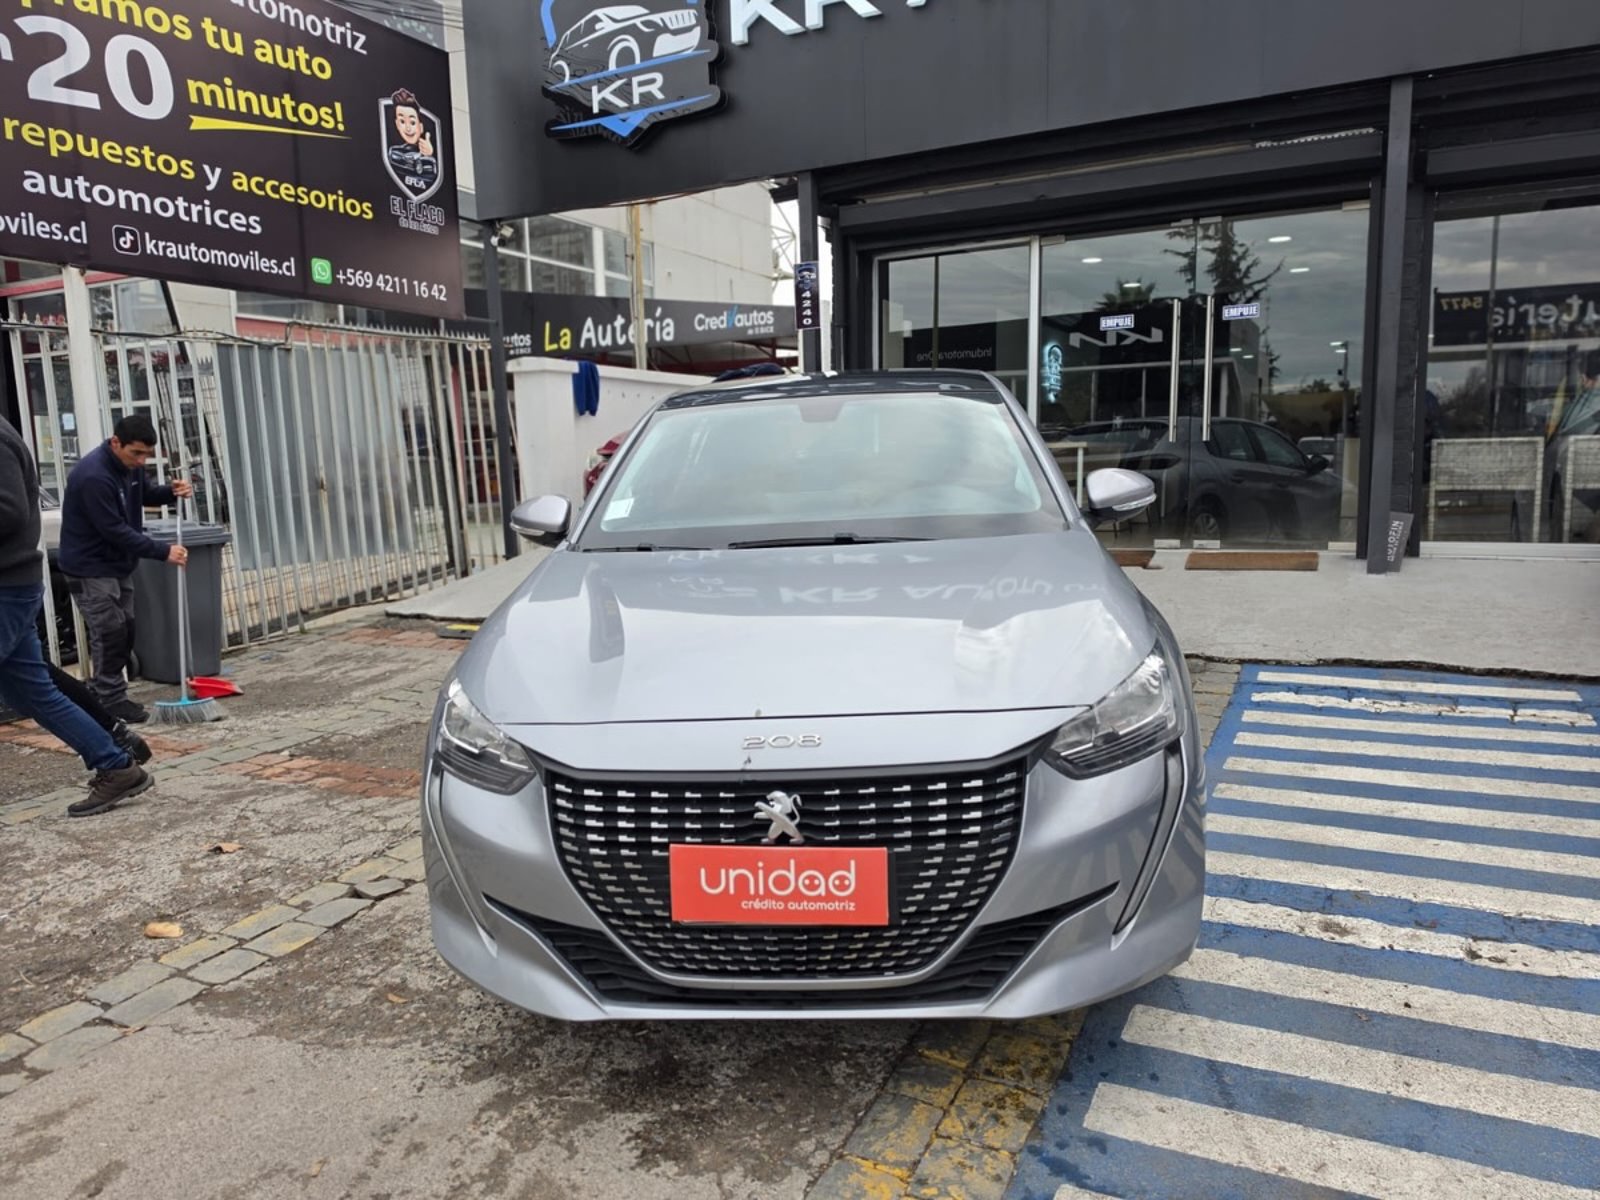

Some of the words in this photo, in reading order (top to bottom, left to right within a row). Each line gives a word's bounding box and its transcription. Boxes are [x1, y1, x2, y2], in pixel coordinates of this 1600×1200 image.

[20, 0, 193, 40] amos
[201, 17, 244, 56] tu
[254, 38, 332, 80] auto
[13, 15, 175, 120] 20
[186, 76, 345, 132] minutos!
[591, 72, 665, 114] KR
[3, 117, 196, 180] repuestos
[202, 163, 222, 191] y
[232, 170, 374, 220] accesorios
[22, 169, 263, 236] automotrices
[0, 213, 88, 244] viles.cl
[145, 231, 296, 277] krautomoviles.cl
[336, 268, 373, 289] +569
[376, 273, 408, 295] 4211
[413, 280, 429, 298] 16
[431, 284, 447, 301] 42
[801, 290, 812, 325] 4240
[1101, 316, 1132, 328] EMPUJE
[1223, 306, 1258, 318] EMPUJE
[544, 321, 572, 352] La
[742, 734, 821, 749] 208
[700, 859, 856, 897] unidad
[741, 899, 784, 911] crédito
[787, 899, 856, 912] automotriz
